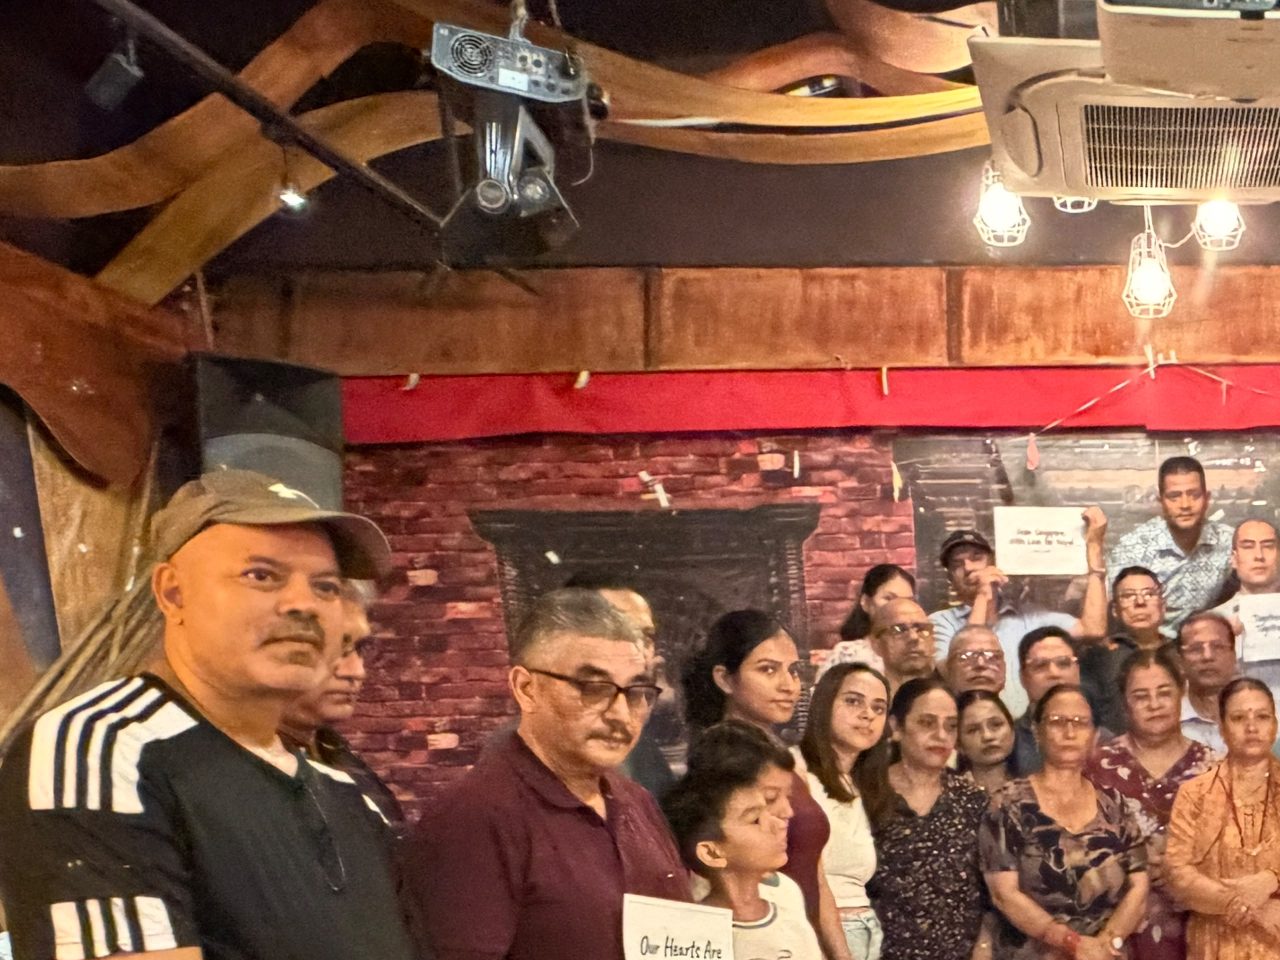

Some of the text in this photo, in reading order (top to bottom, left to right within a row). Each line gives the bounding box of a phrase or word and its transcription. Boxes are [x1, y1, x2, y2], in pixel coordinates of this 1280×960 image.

[640, 935, 722, 959] Our Hearts Are
